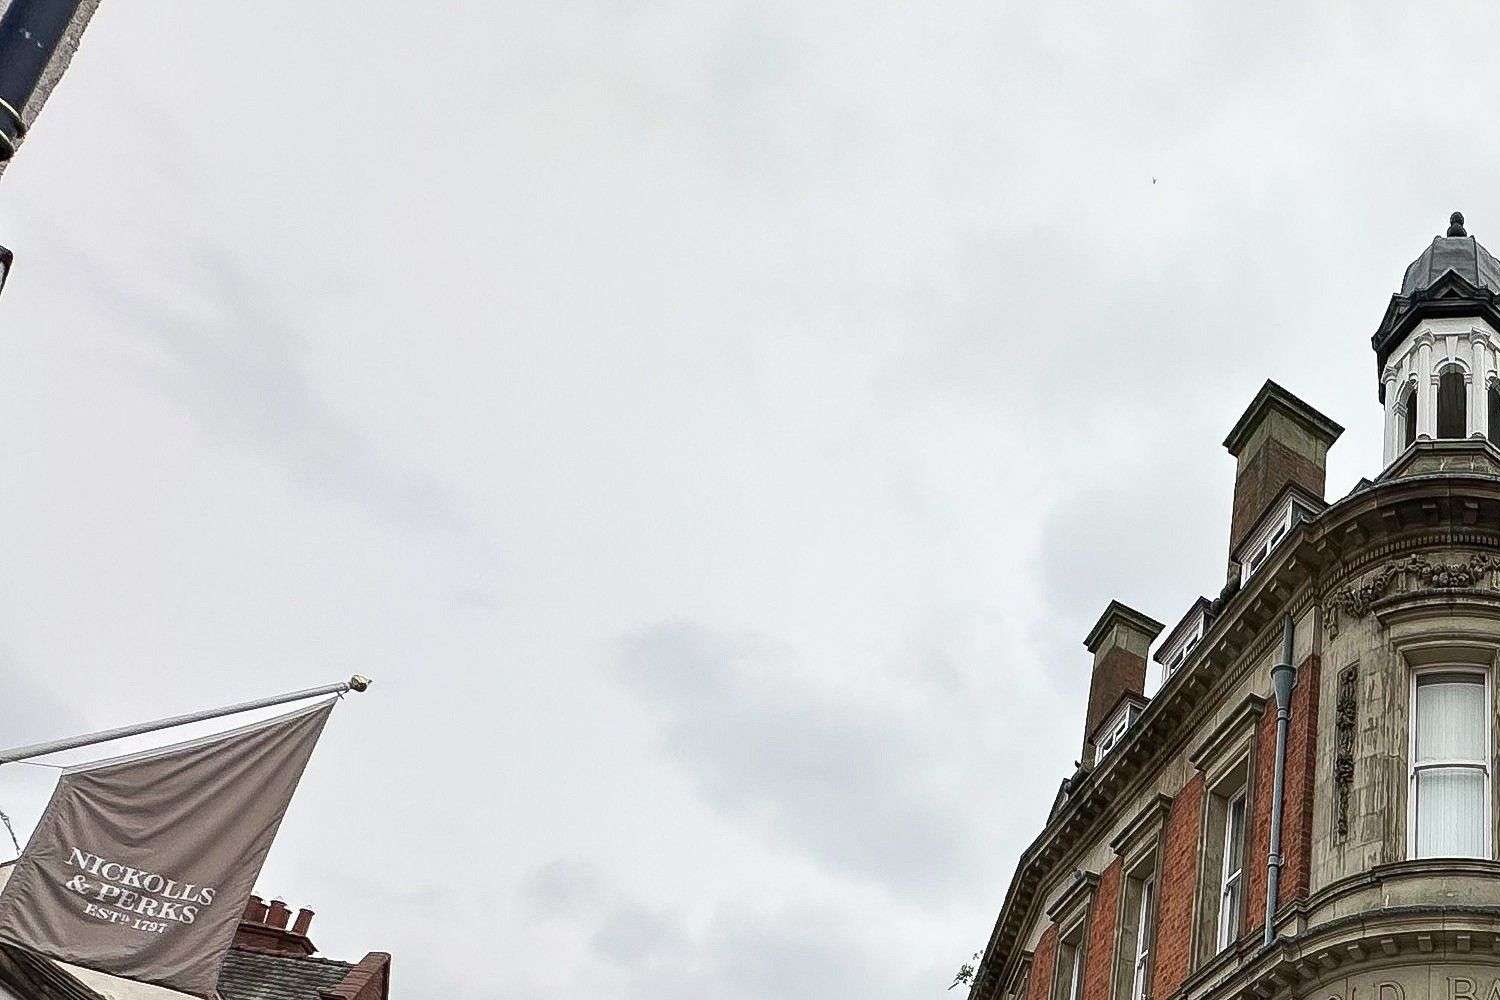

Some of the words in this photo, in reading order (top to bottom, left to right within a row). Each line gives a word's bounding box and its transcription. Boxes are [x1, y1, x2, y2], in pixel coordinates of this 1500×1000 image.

[64, 847, 216, 906] NICKOLLS
[65, 875, 90, 894] &
[96, 882, 199, 924] PERKS
[130, 919, 169, 934] 1797
